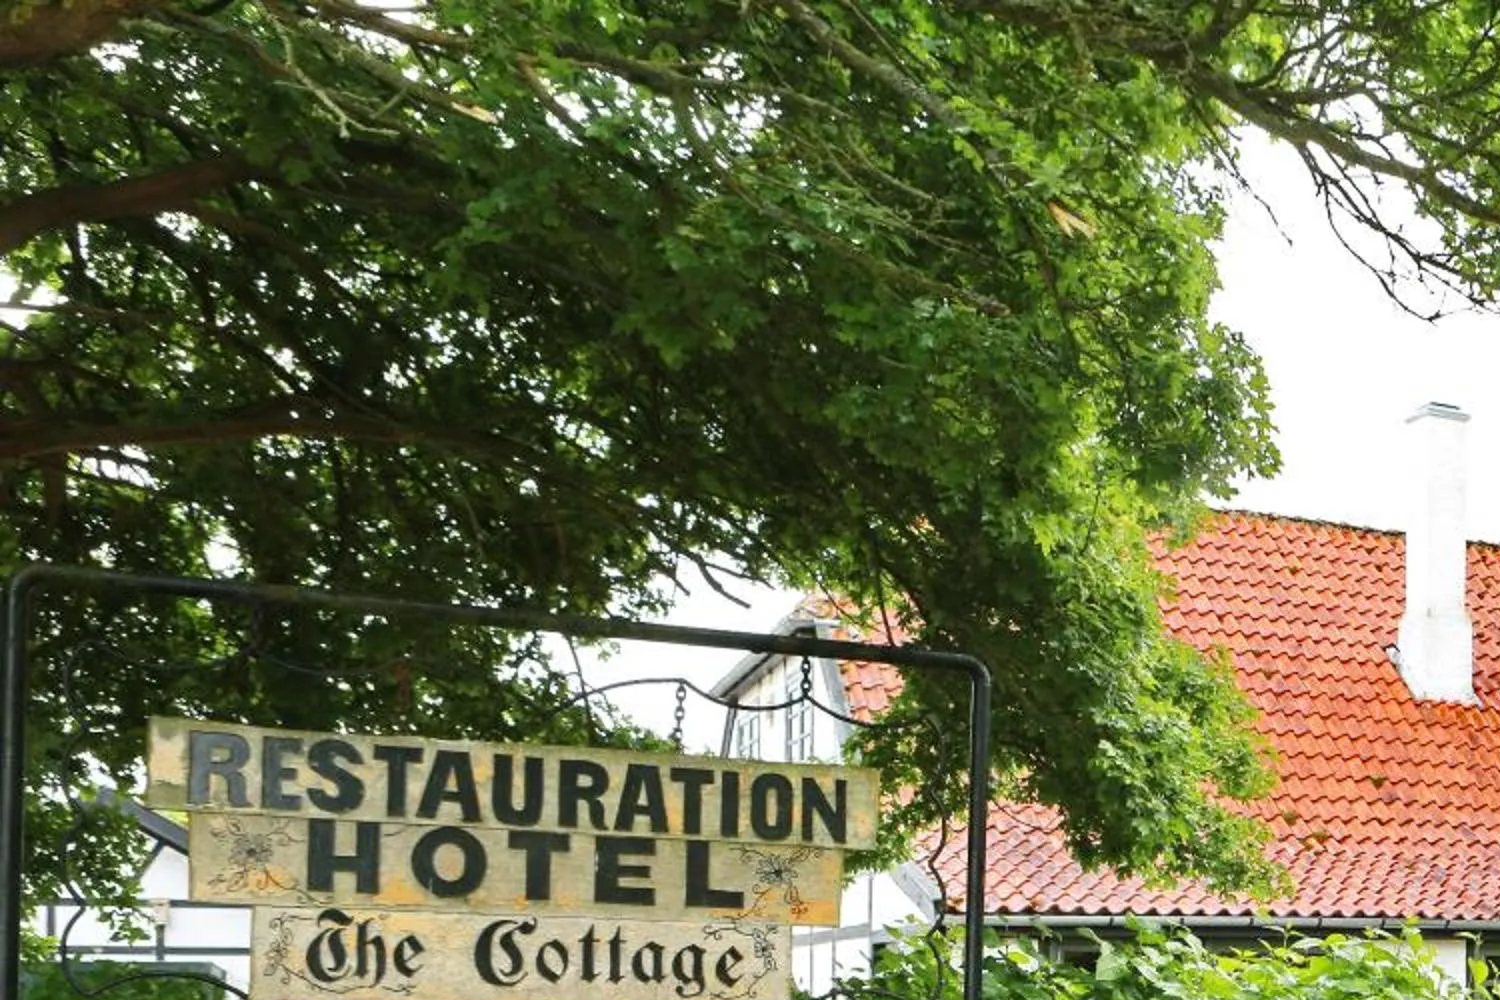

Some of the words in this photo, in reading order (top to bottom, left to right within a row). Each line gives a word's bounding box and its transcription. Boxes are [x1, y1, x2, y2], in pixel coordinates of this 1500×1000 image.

[187, 730, 848, 844] RESTAURATION
[306, 820, 746, 909] HOTEL
[305, 907, 425, 987] The
[474, 917, 745, 998] Cottage
